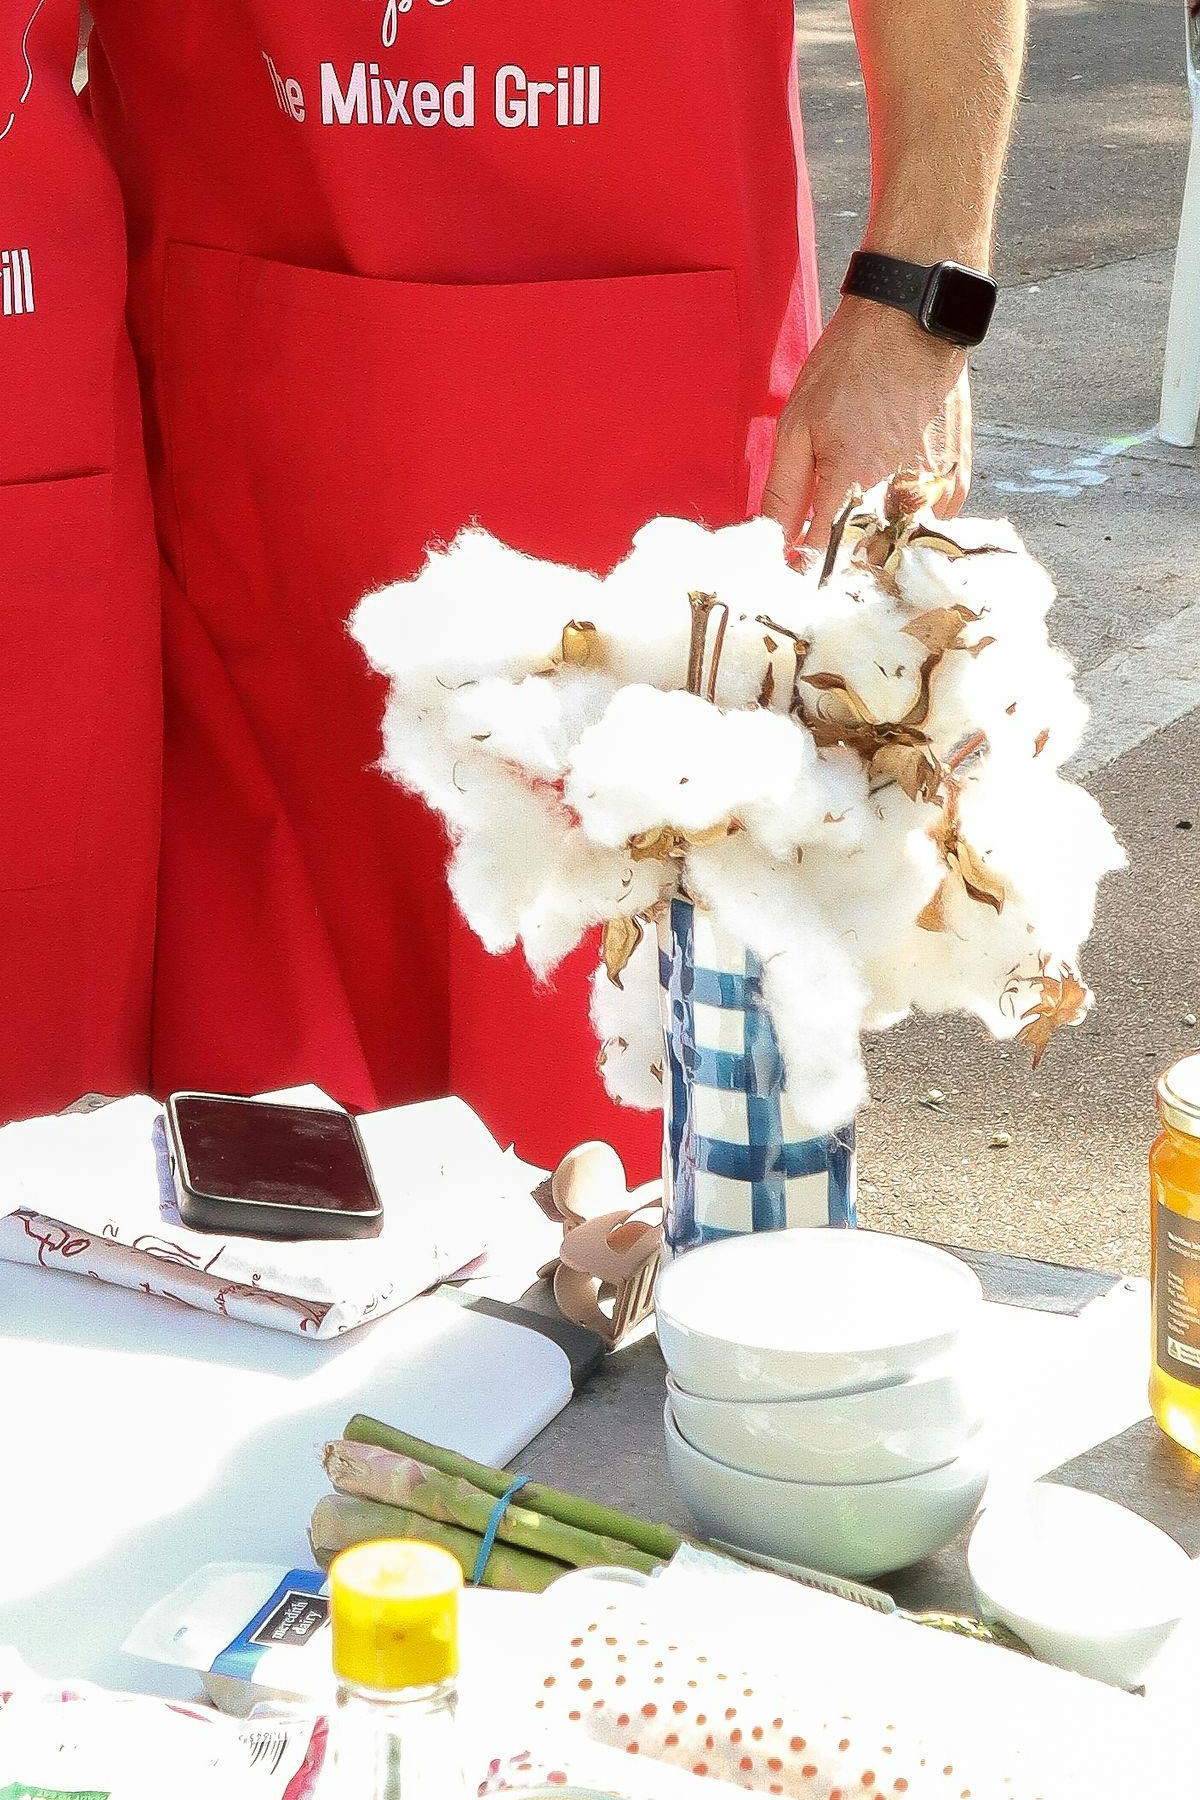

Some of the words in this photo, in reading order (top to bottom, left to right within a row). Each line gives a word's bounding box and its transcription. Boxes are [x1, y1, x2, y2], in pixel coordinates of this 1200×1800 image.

[319, 61, 476, 127] Mixed
[494, 63, 601, 127] Grill
[272, 1601, 308, 1639] meredith
[292, 1611, 322, 1635] dairy
